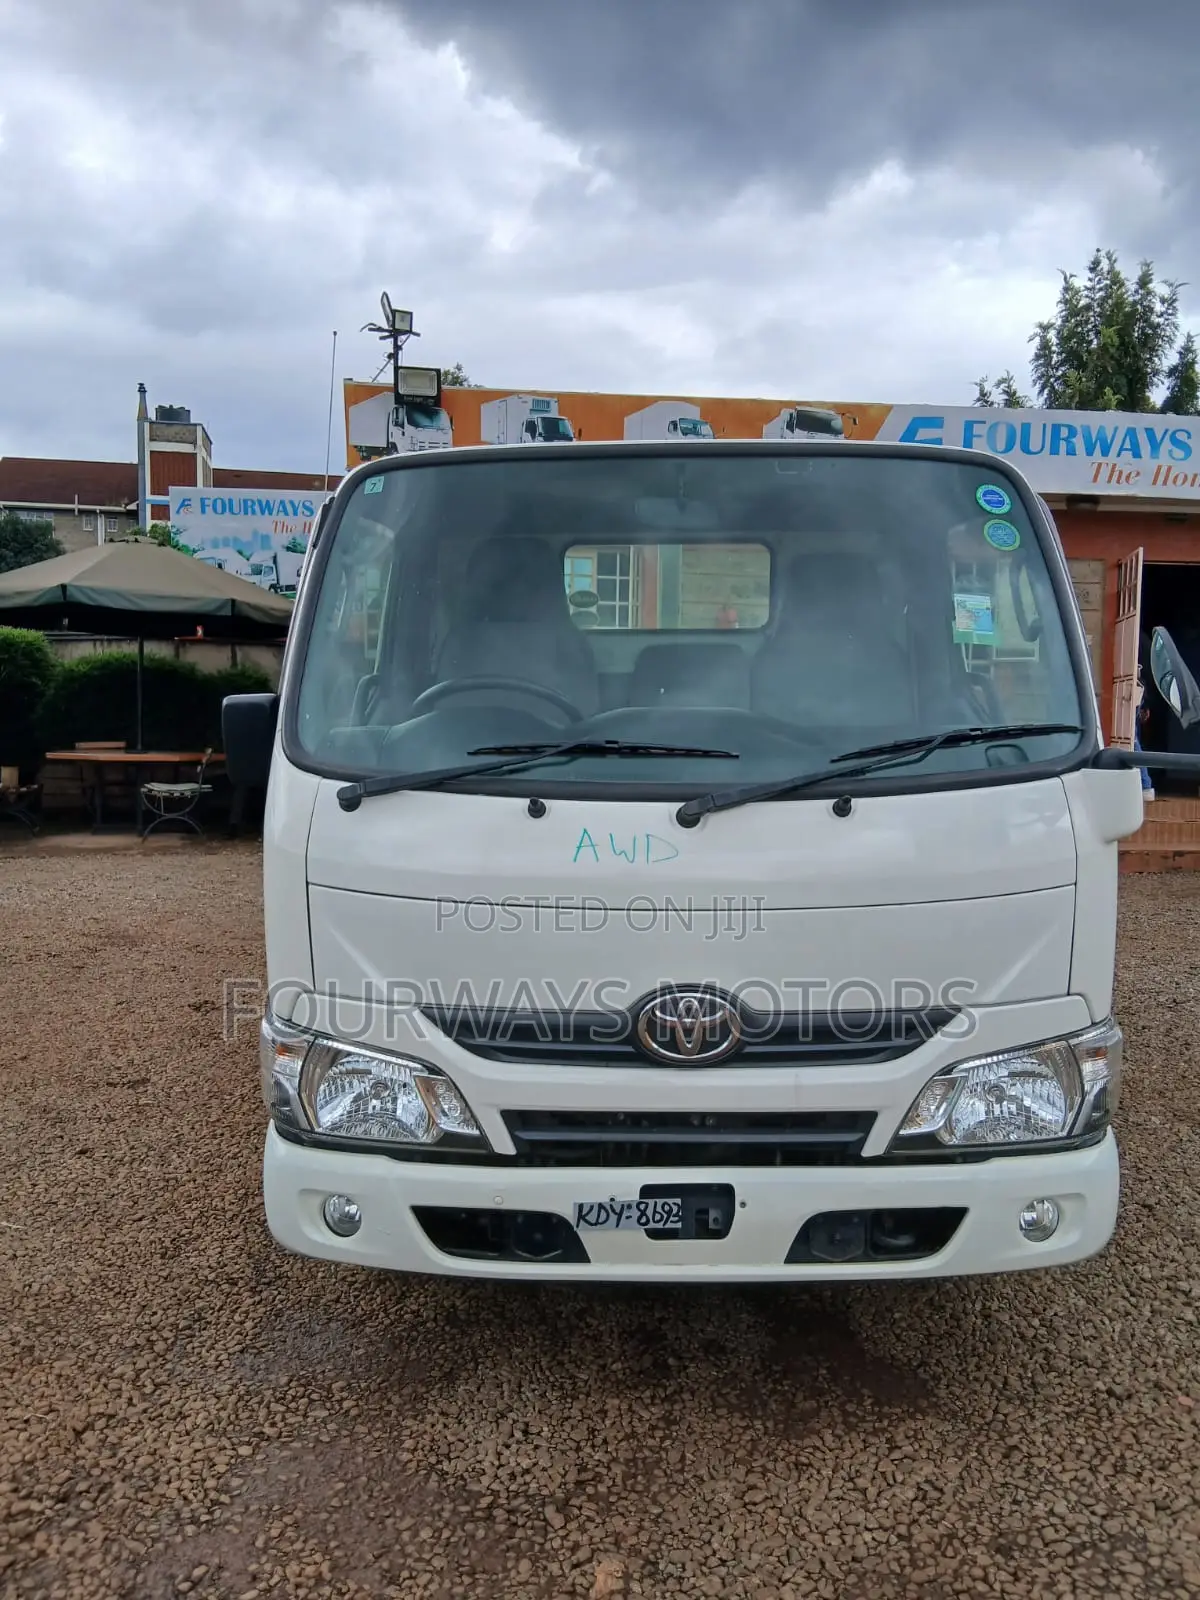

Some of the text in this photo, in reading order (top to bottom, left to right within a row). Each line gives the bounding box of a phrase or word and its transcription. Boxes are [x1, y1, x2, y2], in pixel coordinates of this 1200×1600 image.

[962, 419, 1193, 462] FOURWAYS
[1090, 461, 1141, 485] The
[199, 497, 315, 517] FOURWAYS
[272, 519, 297, 534] The
[572, 827, 679, 865] AWD
